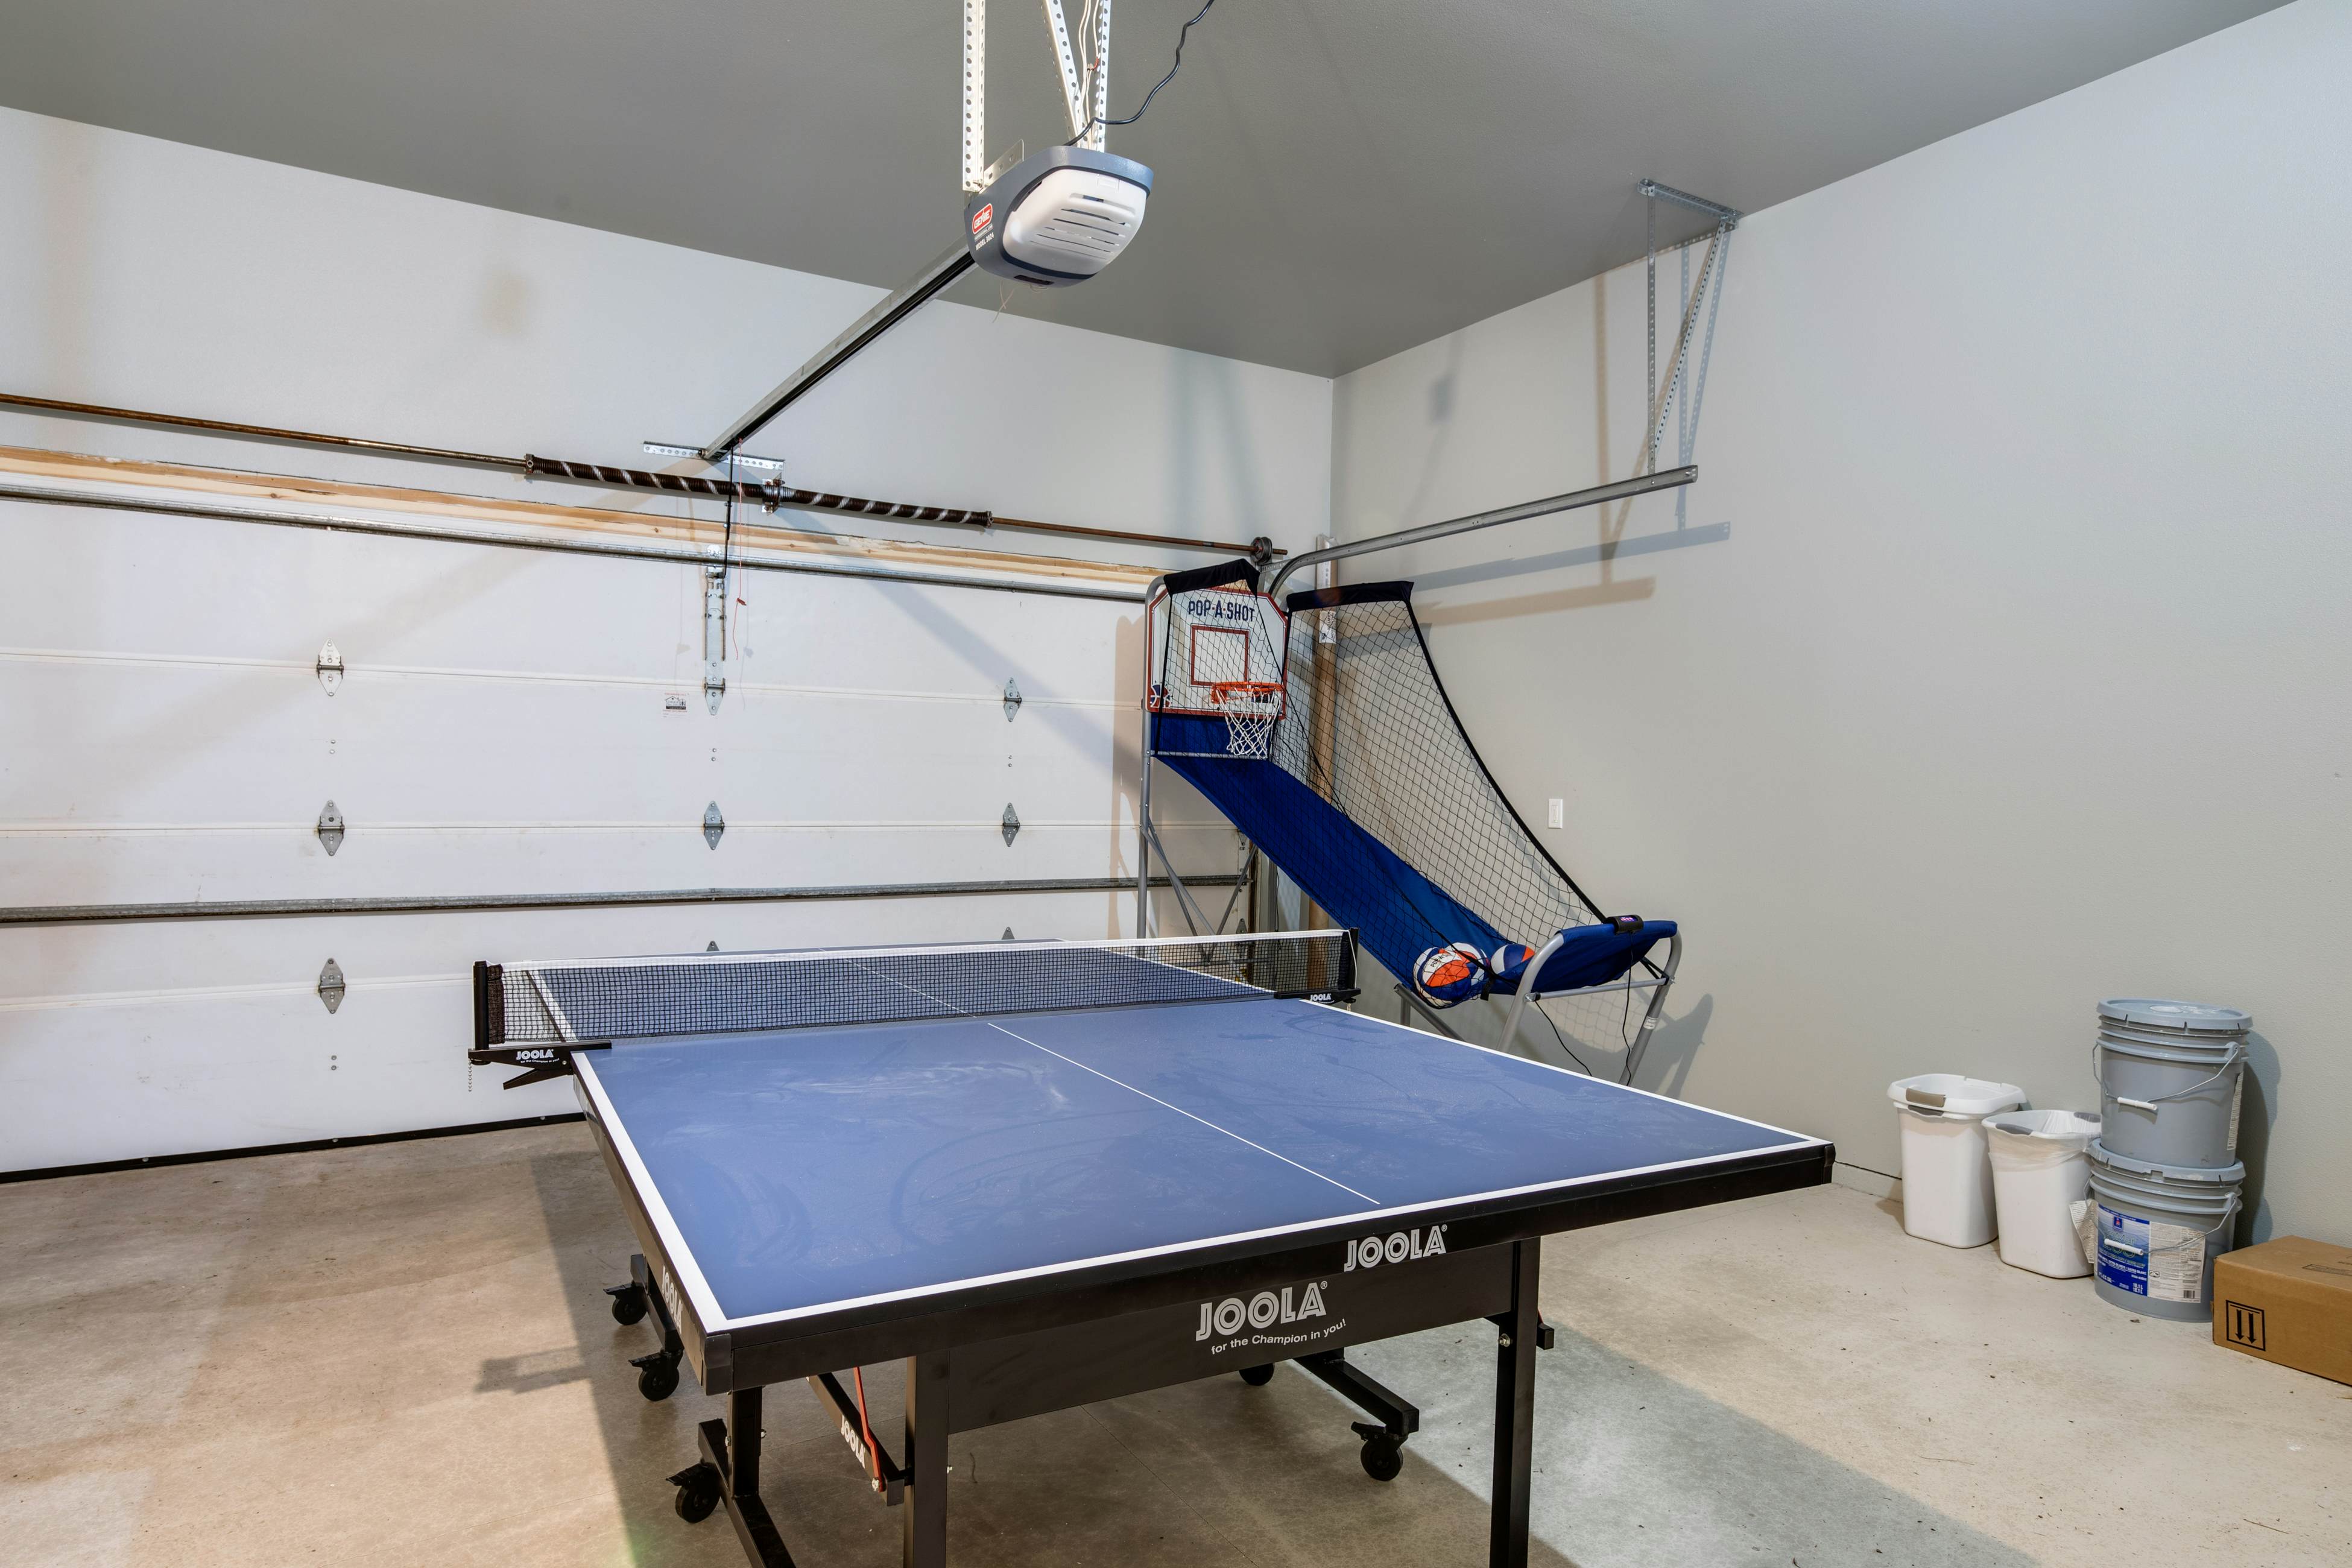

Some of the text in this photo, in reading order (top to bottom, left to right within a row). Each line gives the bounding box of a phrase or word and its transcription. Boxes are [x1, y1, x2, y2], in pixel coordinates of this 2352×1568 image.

[1211, 1318, 1346, 1355] for the Champion in you!
